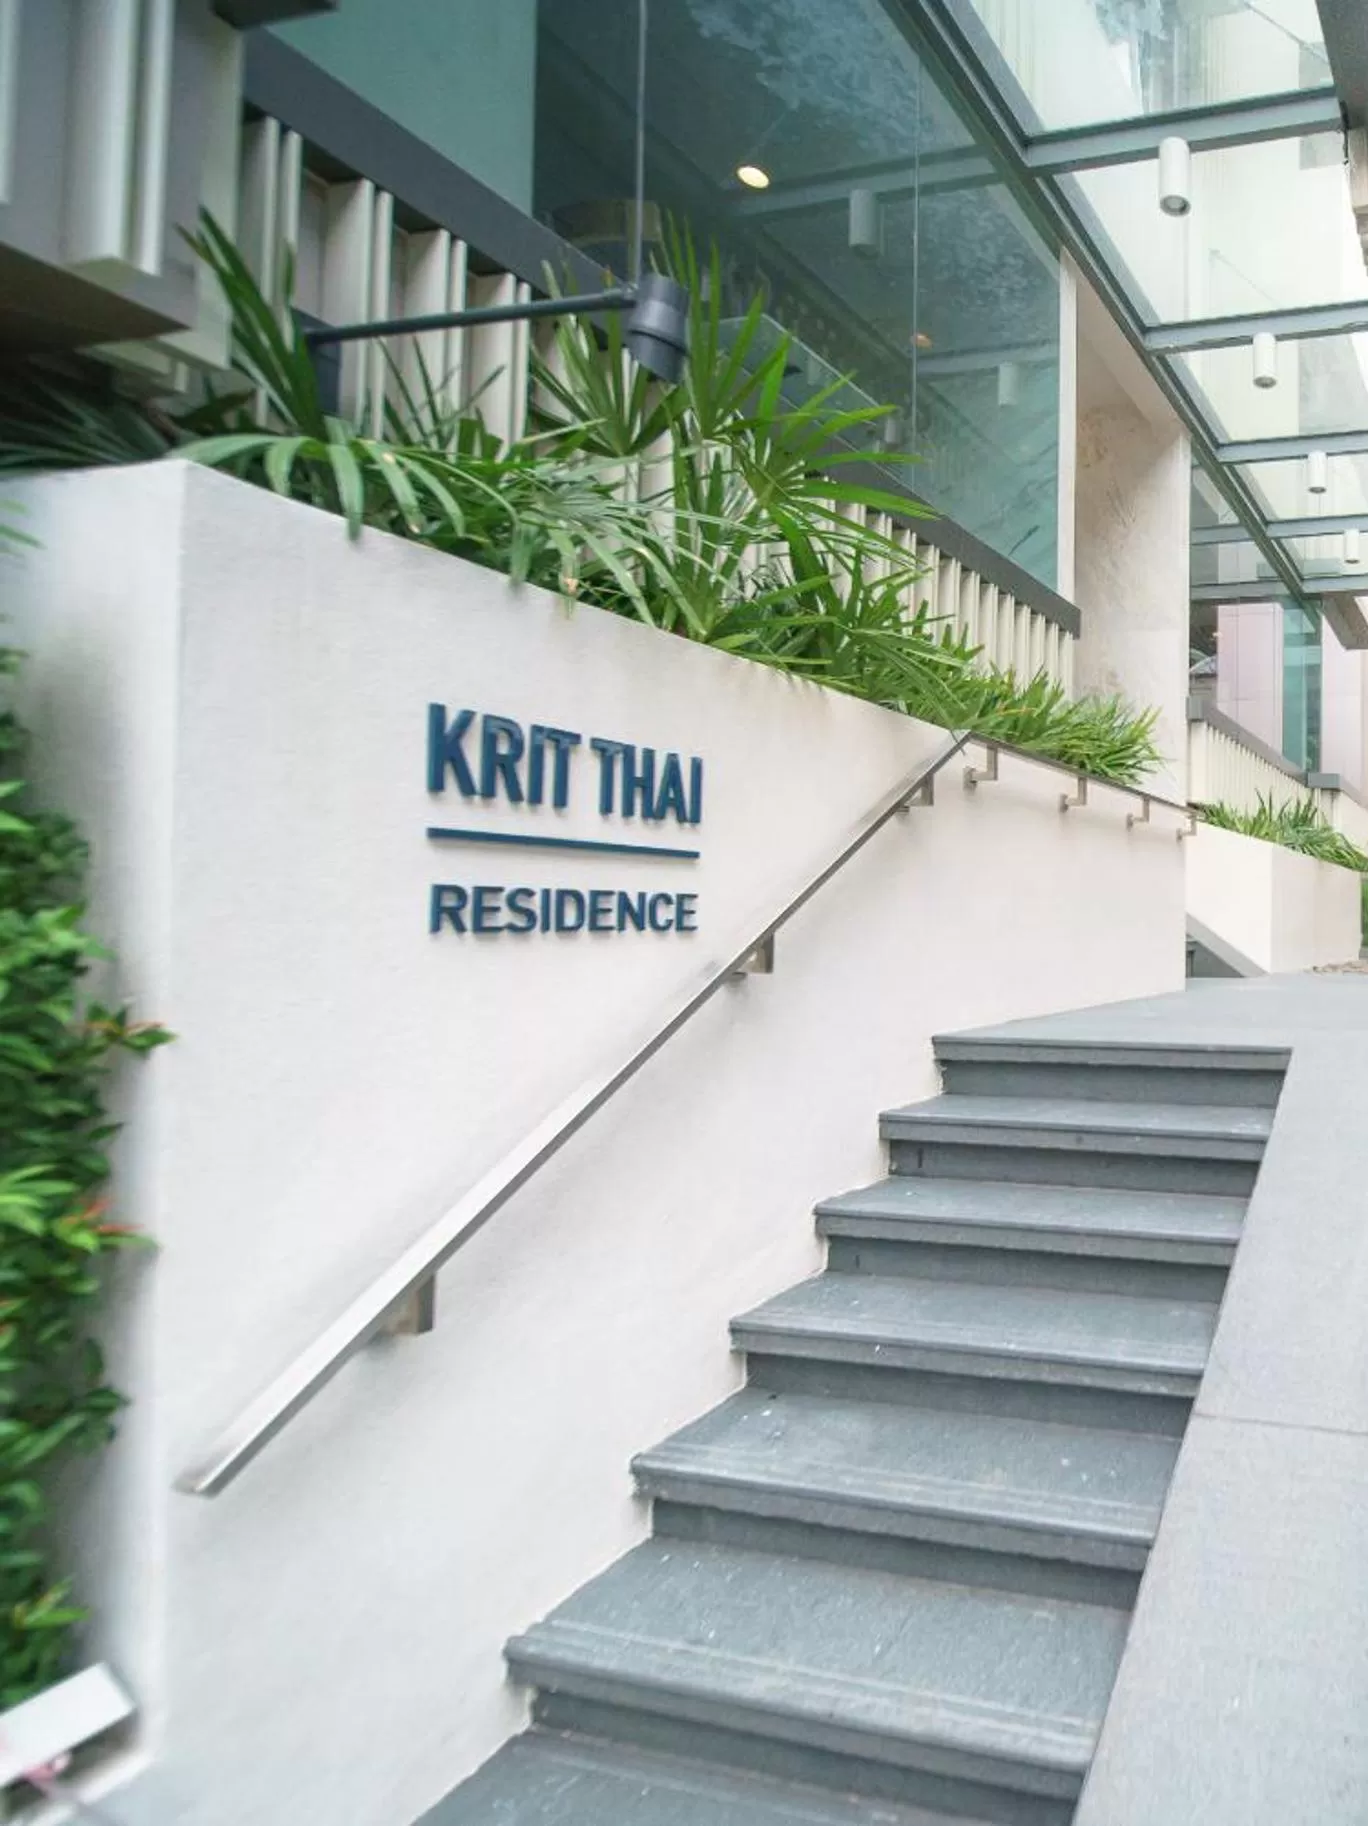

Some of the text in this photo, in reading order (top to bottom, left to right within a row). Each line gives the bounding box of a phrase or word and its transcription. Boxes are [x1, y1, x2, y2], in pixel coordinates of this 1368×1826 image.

[427, 702, 703, 824] KRIT THAI
[428, 883, 699, 934] RESIDENCE
